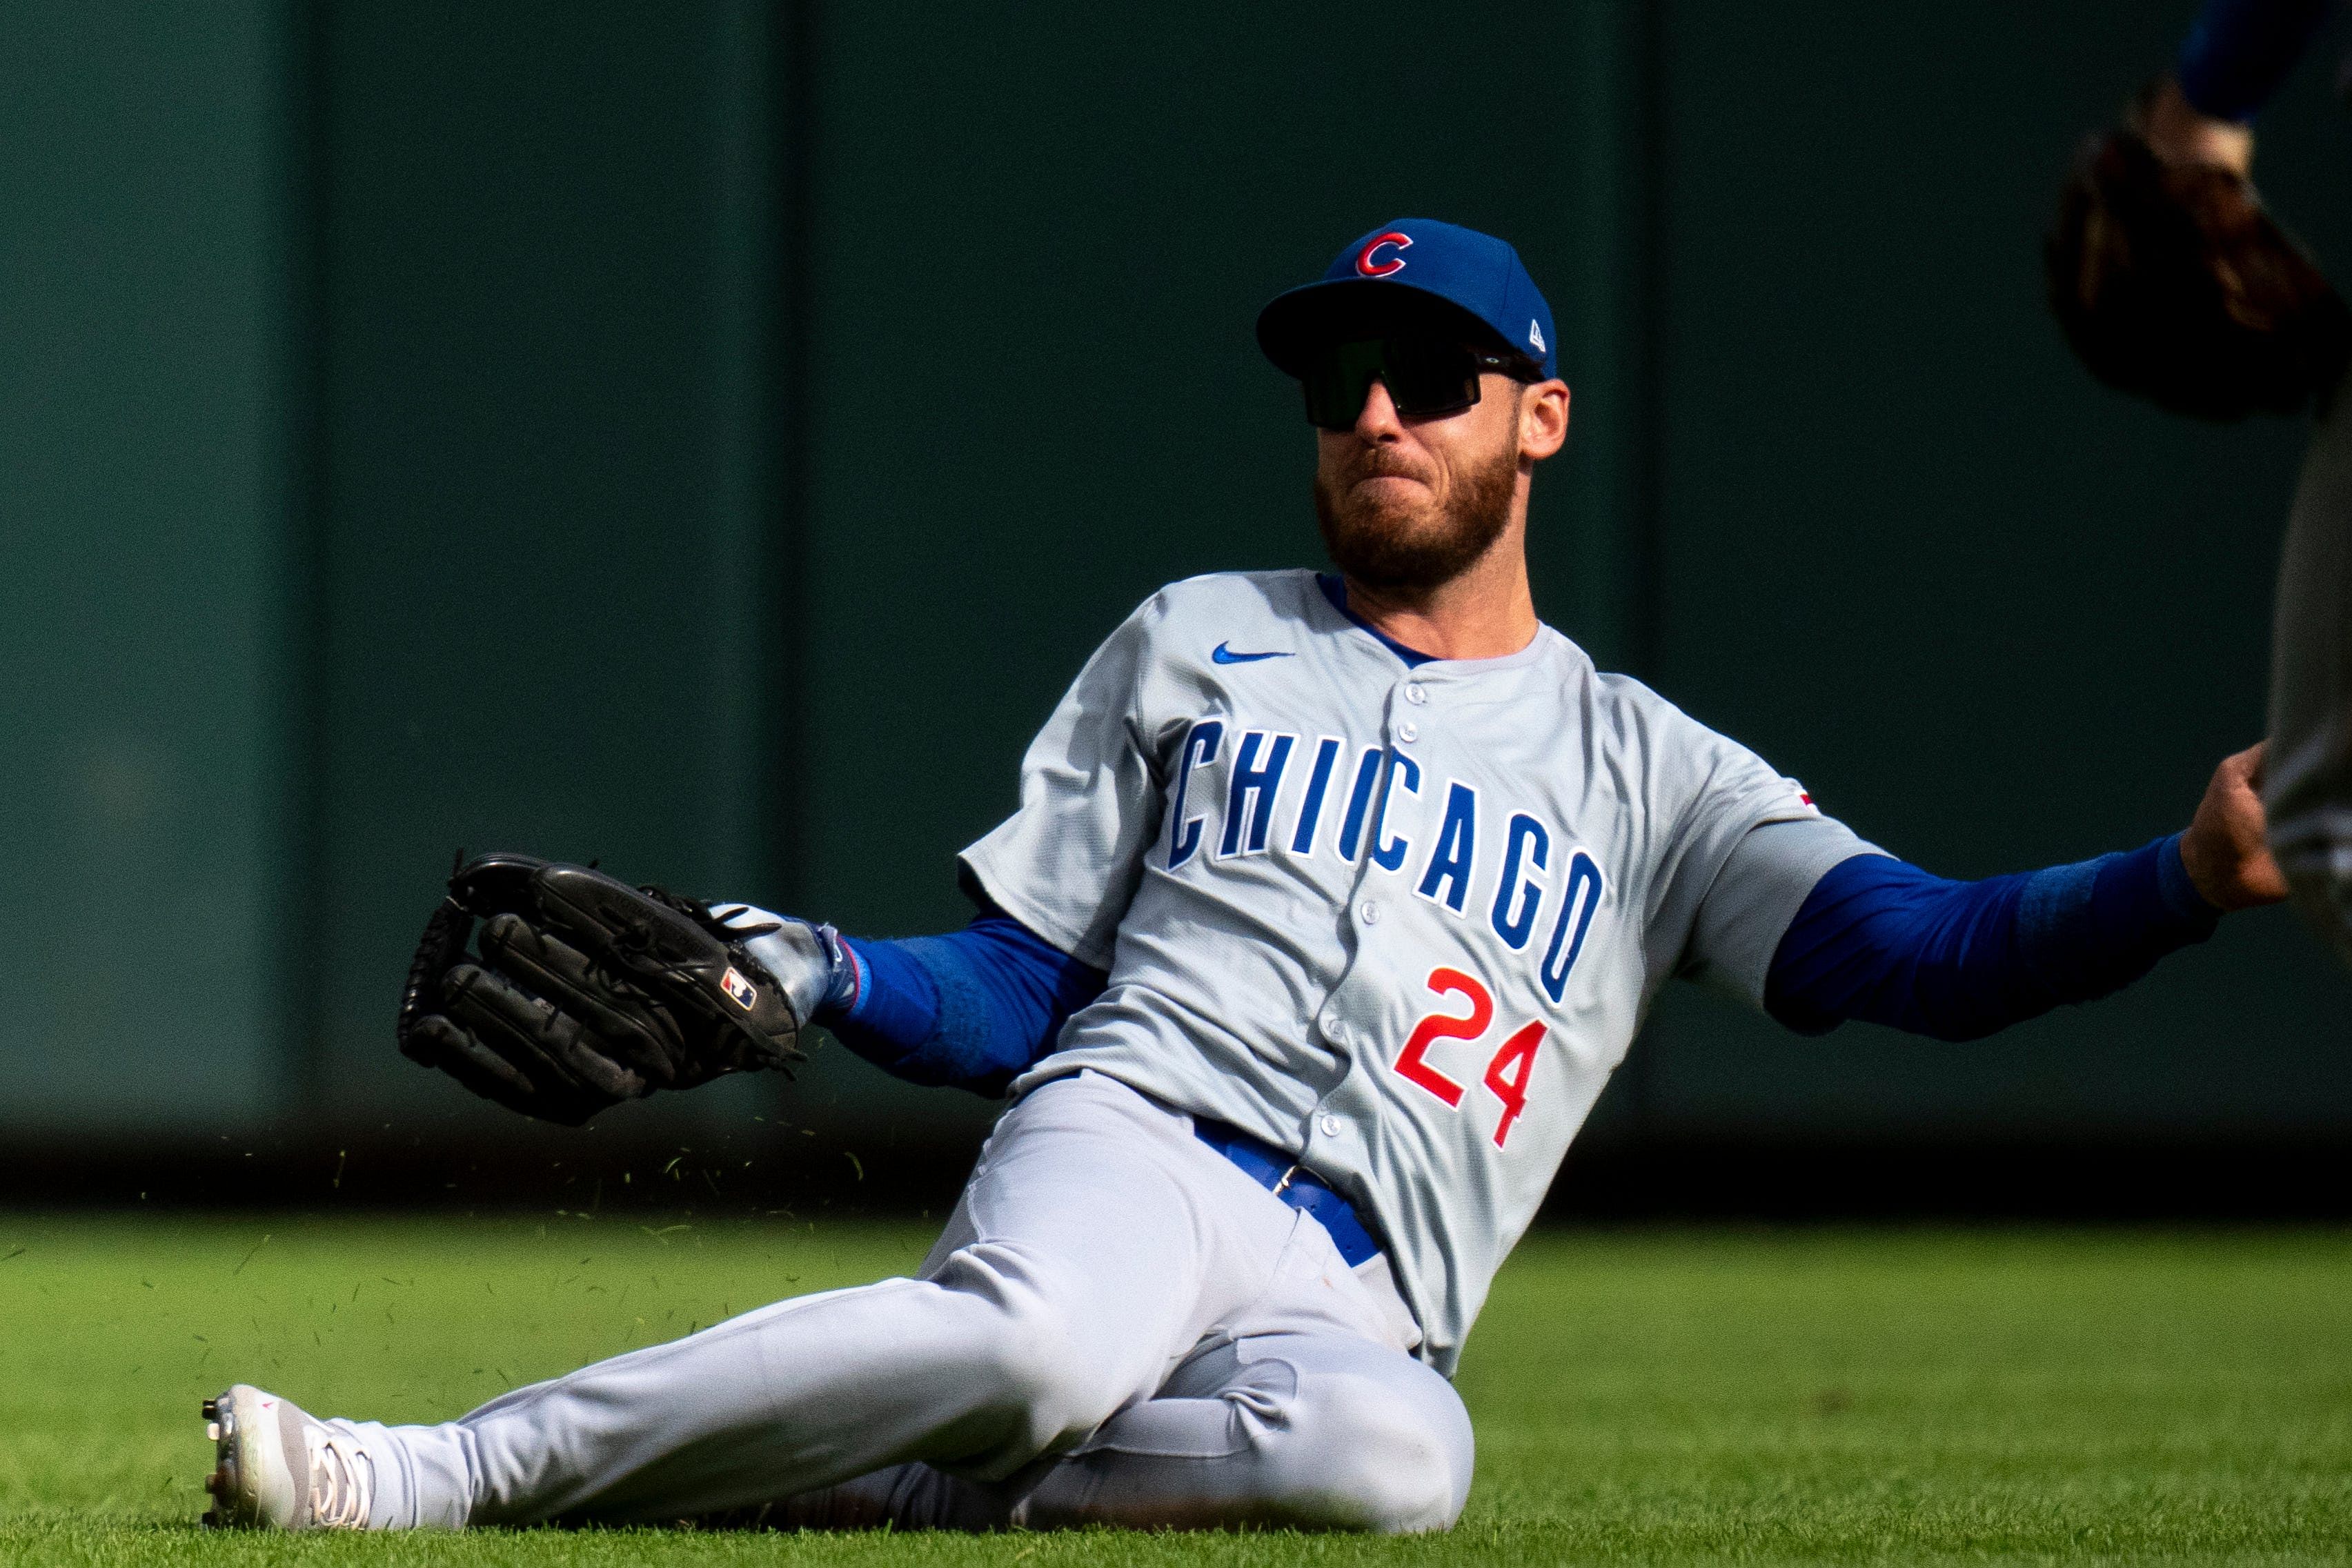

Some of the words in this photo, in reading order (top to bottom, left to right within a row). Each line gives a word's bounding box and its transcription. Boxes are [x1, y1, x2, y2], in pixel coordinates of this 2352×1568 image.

[1356, 232, 1414, 277] C
[1167, 716, 1605, 1008] CHICAGO
[1392, 966, 1548, 1151] 24
